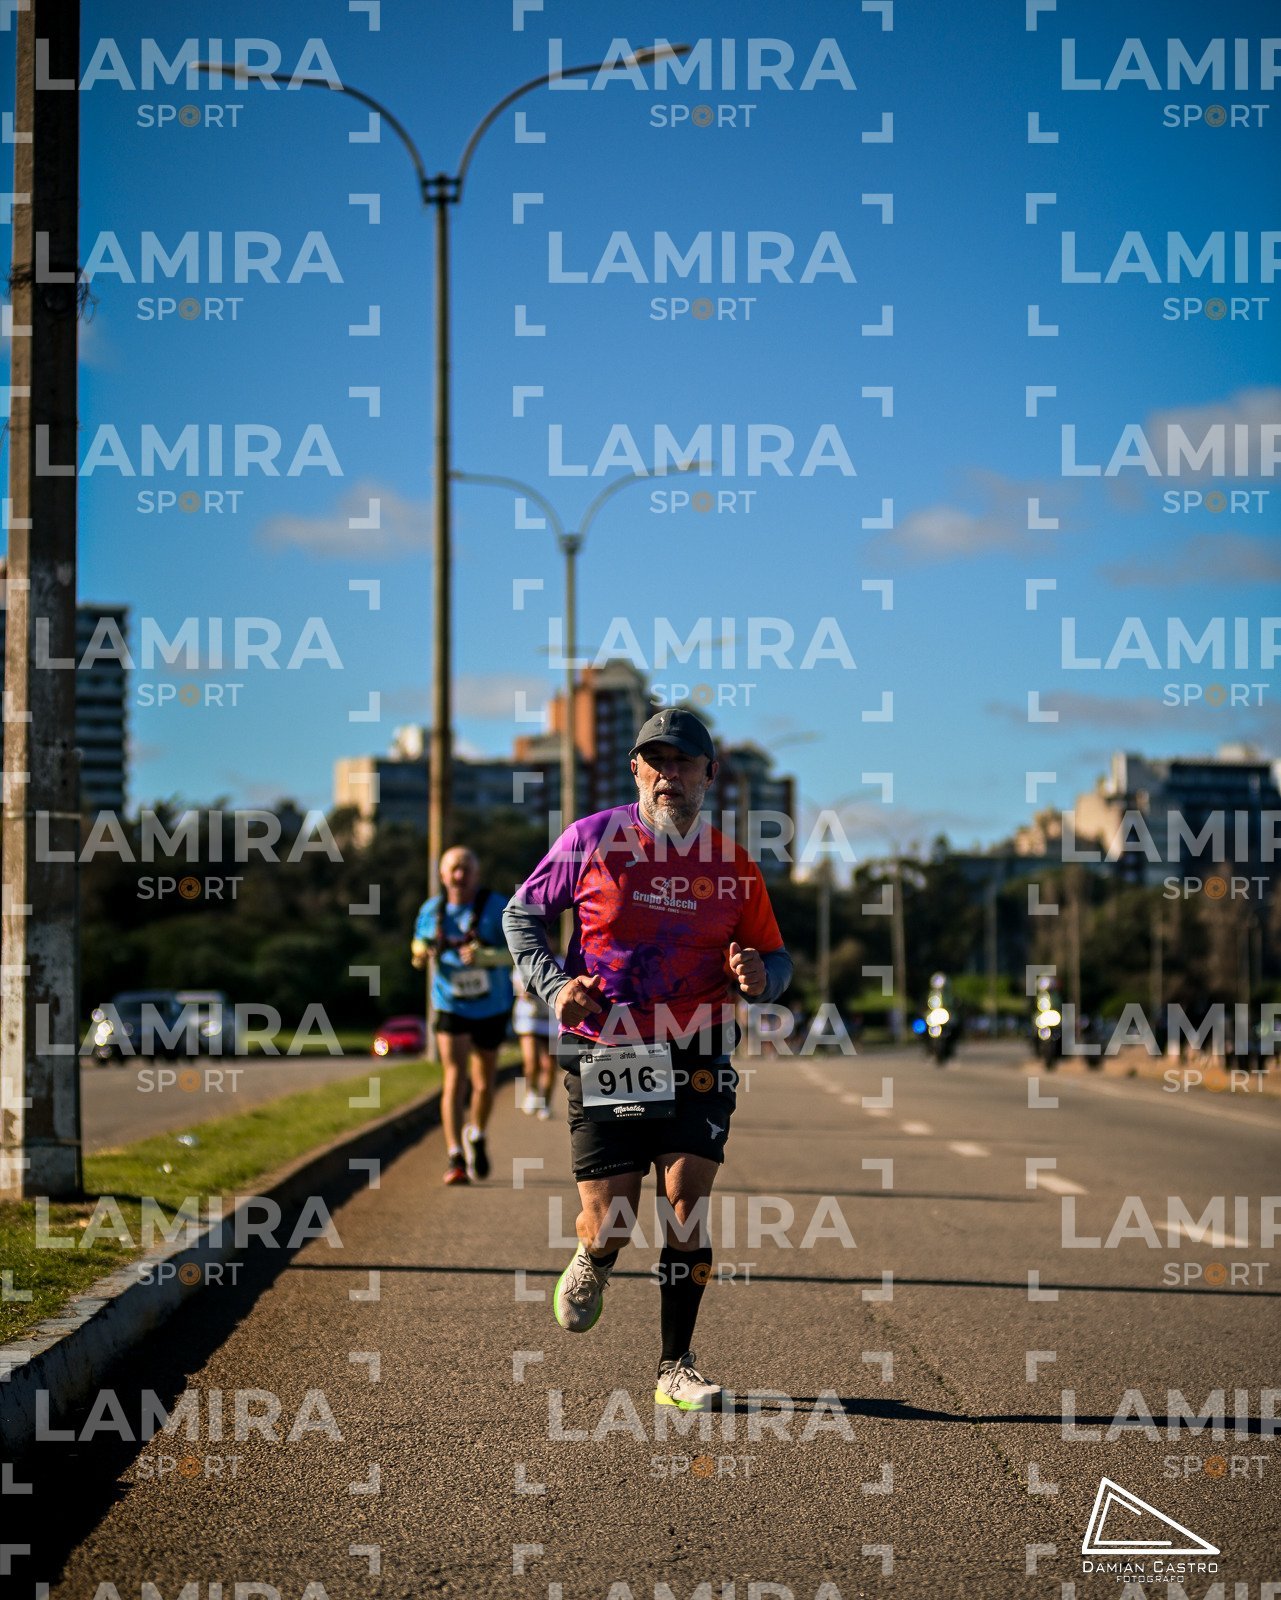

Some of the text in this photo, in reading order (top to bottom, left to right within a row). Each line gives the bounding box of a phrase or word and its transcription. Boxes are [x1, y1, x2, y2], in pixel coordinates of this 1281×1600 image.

[633, 890, 697, 910] Grupo Sacchi
[598, 1066, 656, 1095] 916
